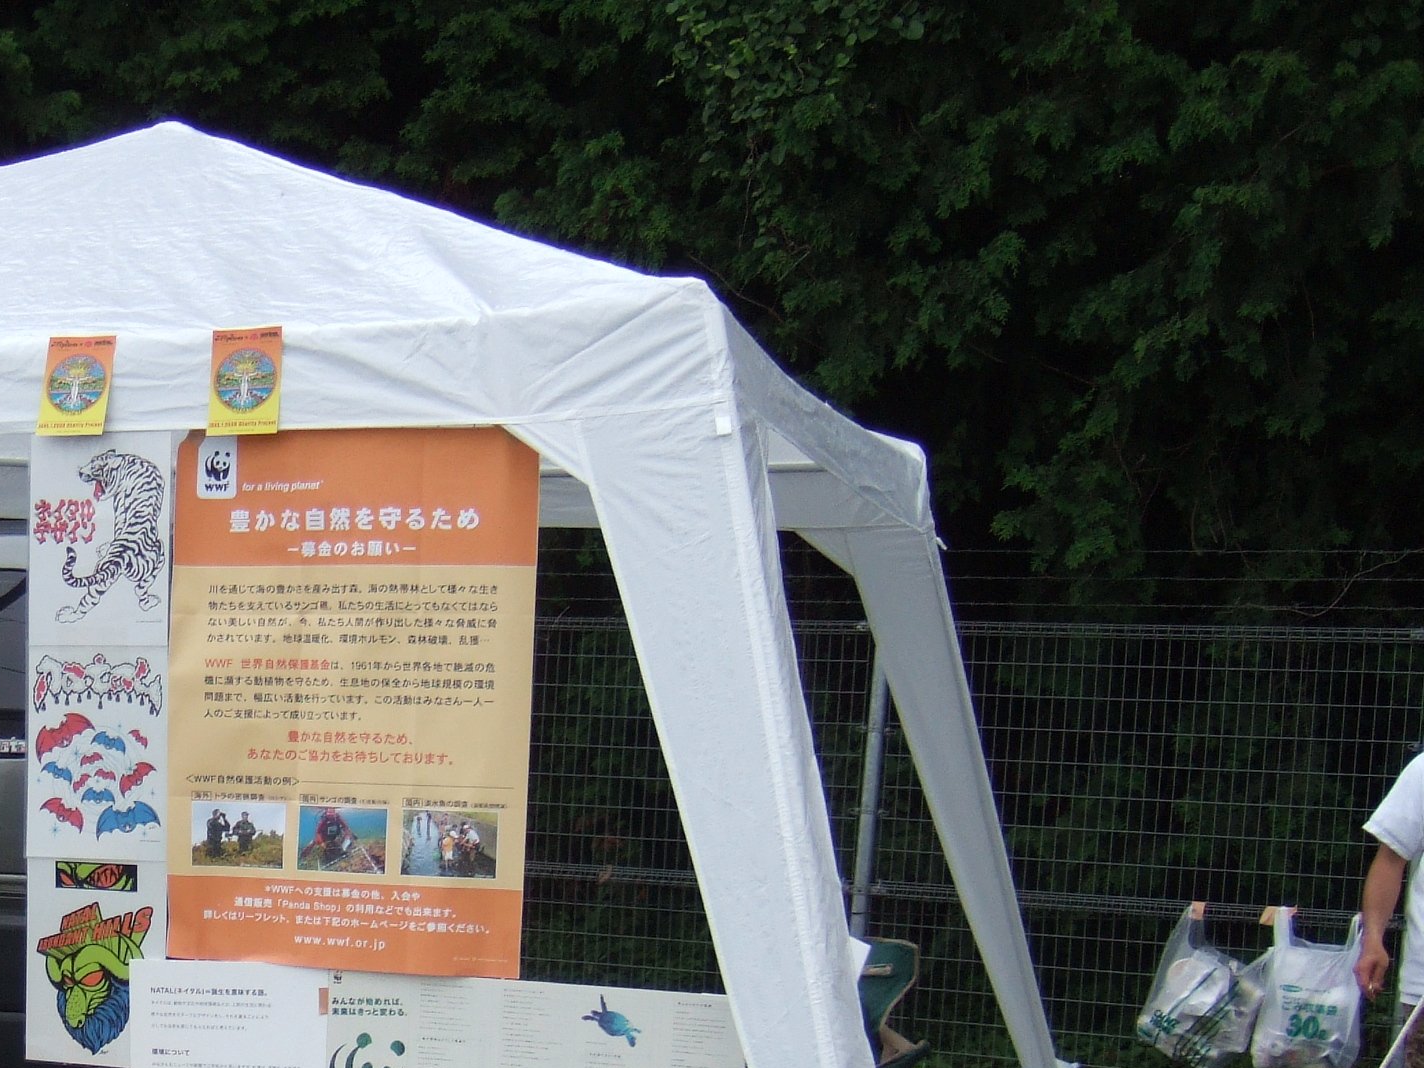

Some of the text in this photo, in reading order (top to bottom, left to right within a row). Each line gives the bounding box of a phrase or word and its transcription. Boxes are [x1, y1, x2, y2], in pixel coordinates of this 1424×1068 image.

[205, 482, 229, 492] WWF
[242, 482, 255, 492] for
[265, 481, 289, 493] living
[290, 481, 321, 492] planet
[229, 506, 480, 532] 豊かな自然を守るため
[287, 730, 413, 746] 豊かな自然を守るため、
[247, 748, 456, 767] あなたのご協力をお待ちしております。
[294, 934, 387, 951] www.wwf.or.jp
